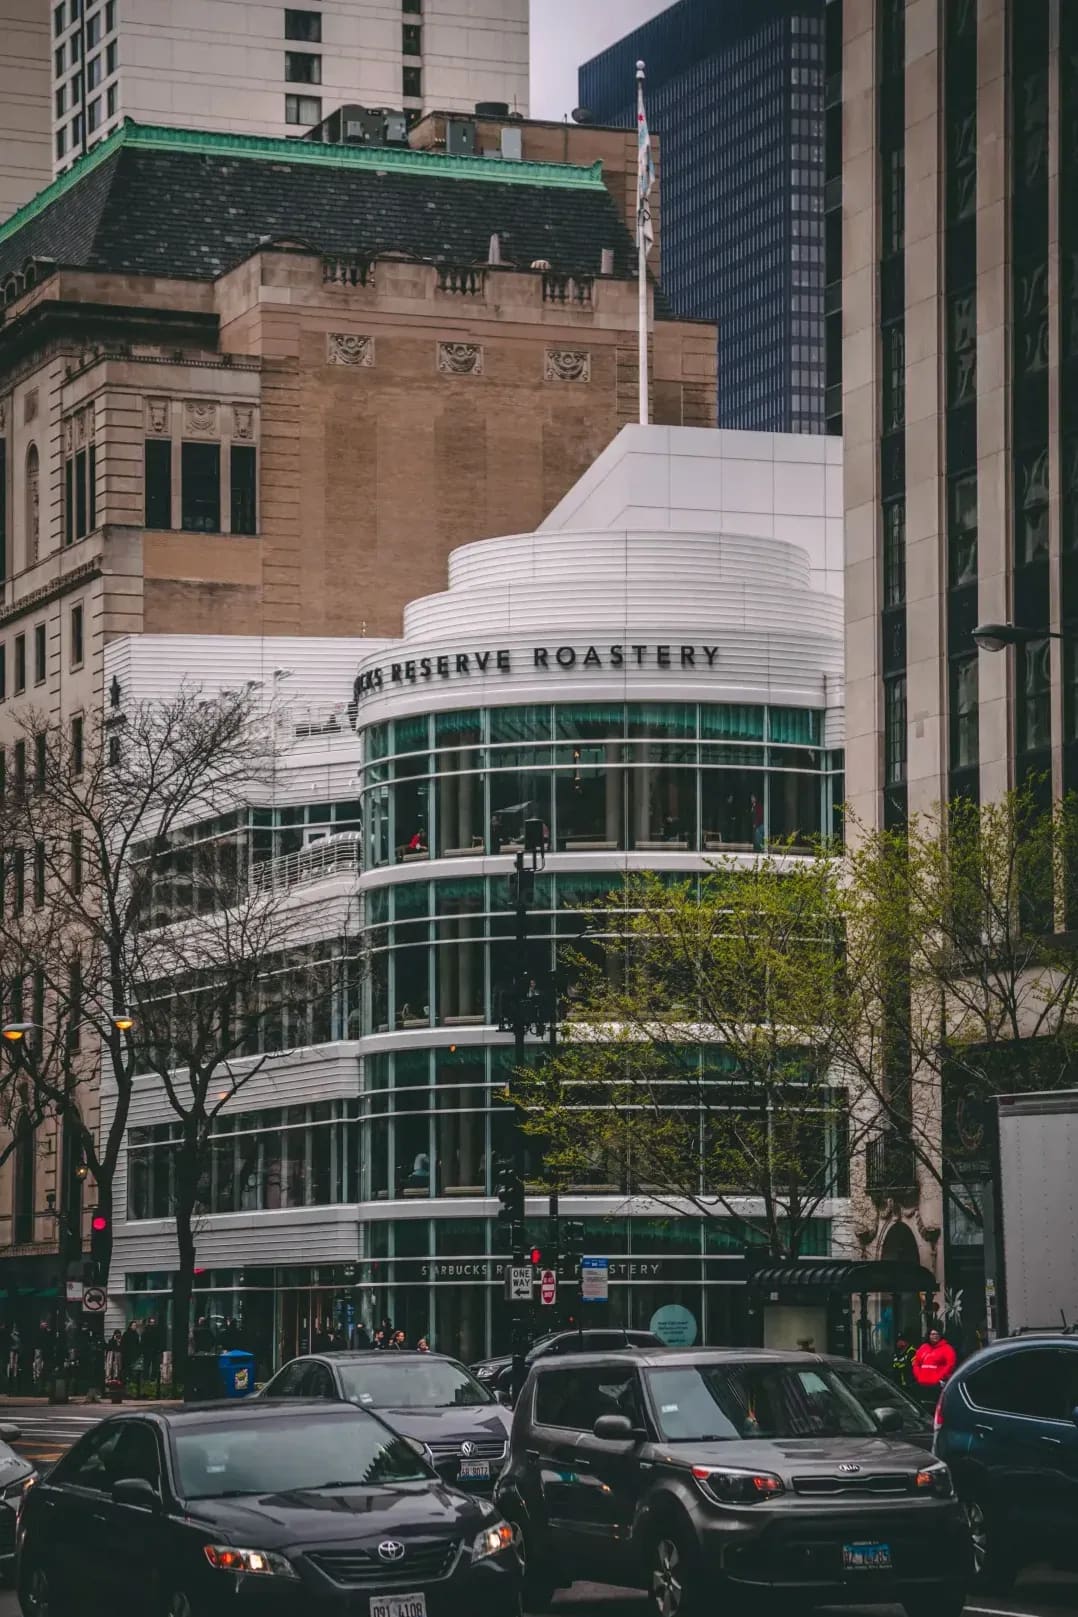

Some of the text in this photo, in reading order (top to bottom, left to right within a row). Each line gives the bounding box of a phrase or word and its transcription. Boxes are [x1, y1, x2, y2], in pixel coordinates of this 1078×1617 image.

[392, 649, 510, 682] RESERVE
[534, 645, 719, 667] ROASTERY
[421, 1264, 487, 1275] SARBUCKS
[513, 1270, 531, 1278] ONE
[513, 1279, 531, 1287] WAY
